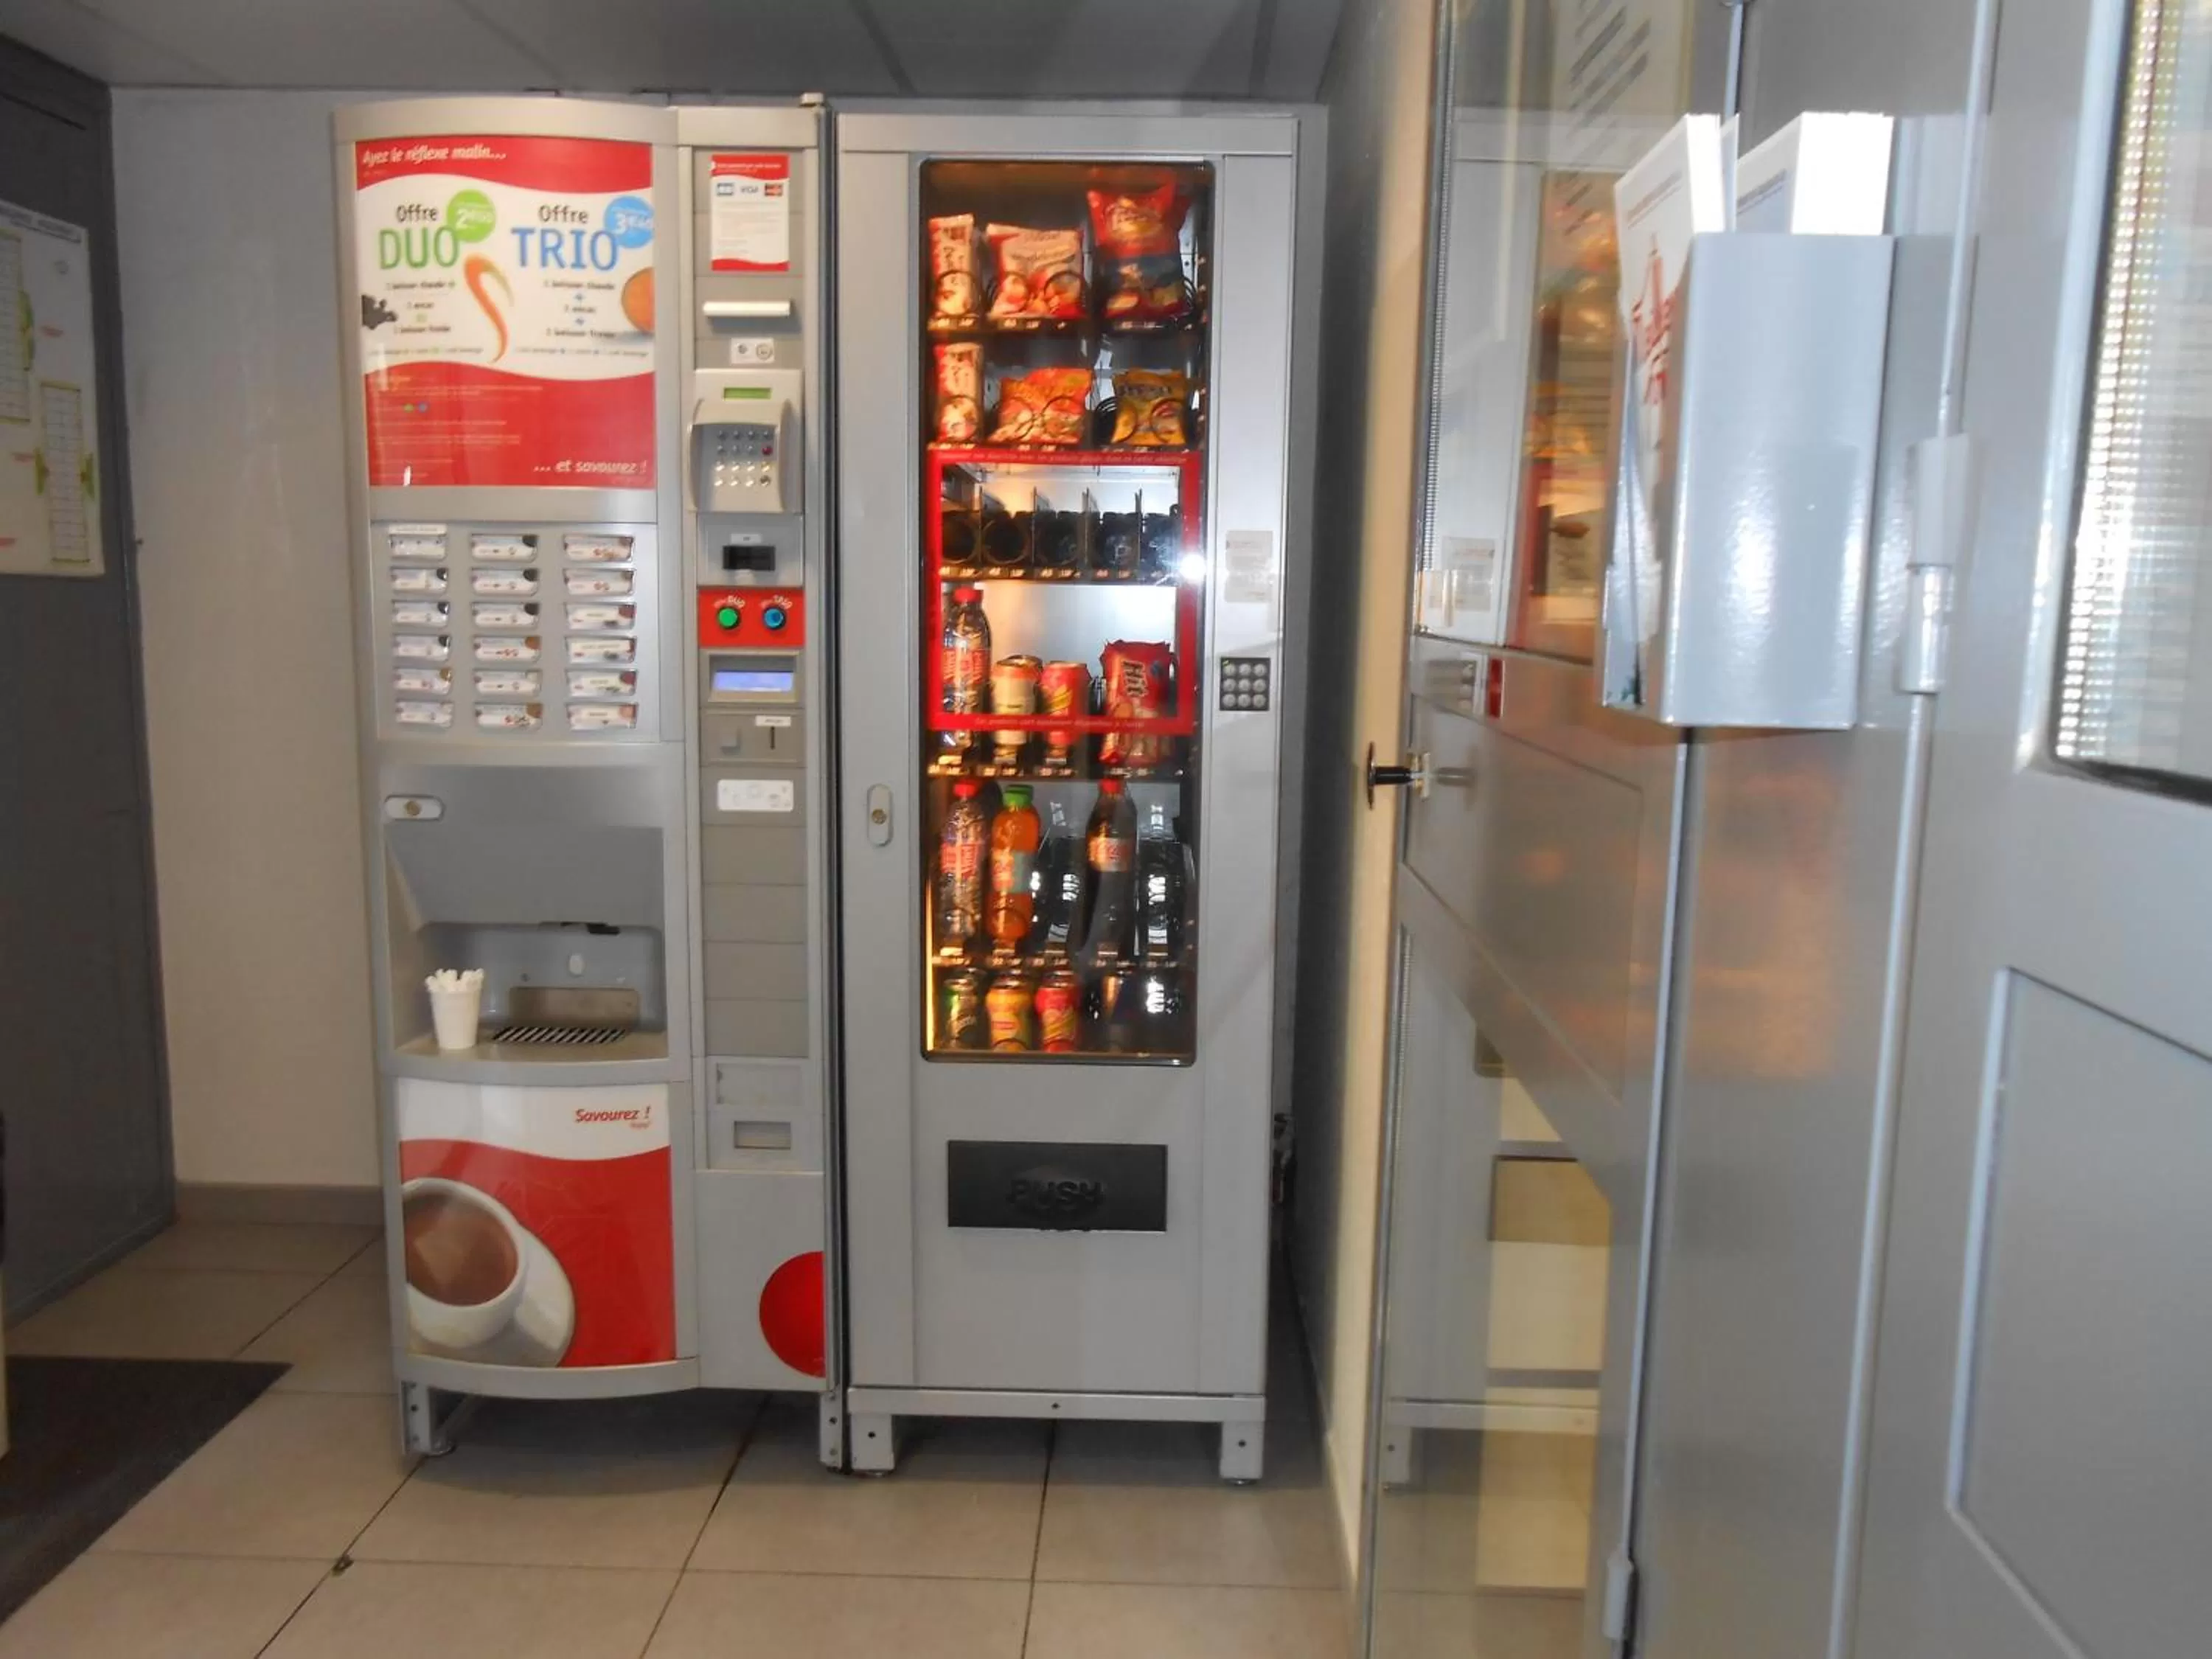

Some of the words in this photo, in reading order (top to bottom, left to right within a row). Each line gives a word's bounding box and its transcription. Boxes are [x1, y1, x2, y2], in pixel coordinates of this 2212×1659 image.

[391, 147, 404, 162] le
[405, 145, 449, 164] réflexe
[396, 204, 438, 222] Offre
[538, 204, 588, 223] Offre
[379, 226, 459, 270] DUO
[510, 227, 618, 271] TRIO
[556, 459, 571, 473] et
[575, 460, 637, 473] savourez
[575, 1108, 640, 1123] Savourez
[1005, 1178, 1104, 1208] PUSH
